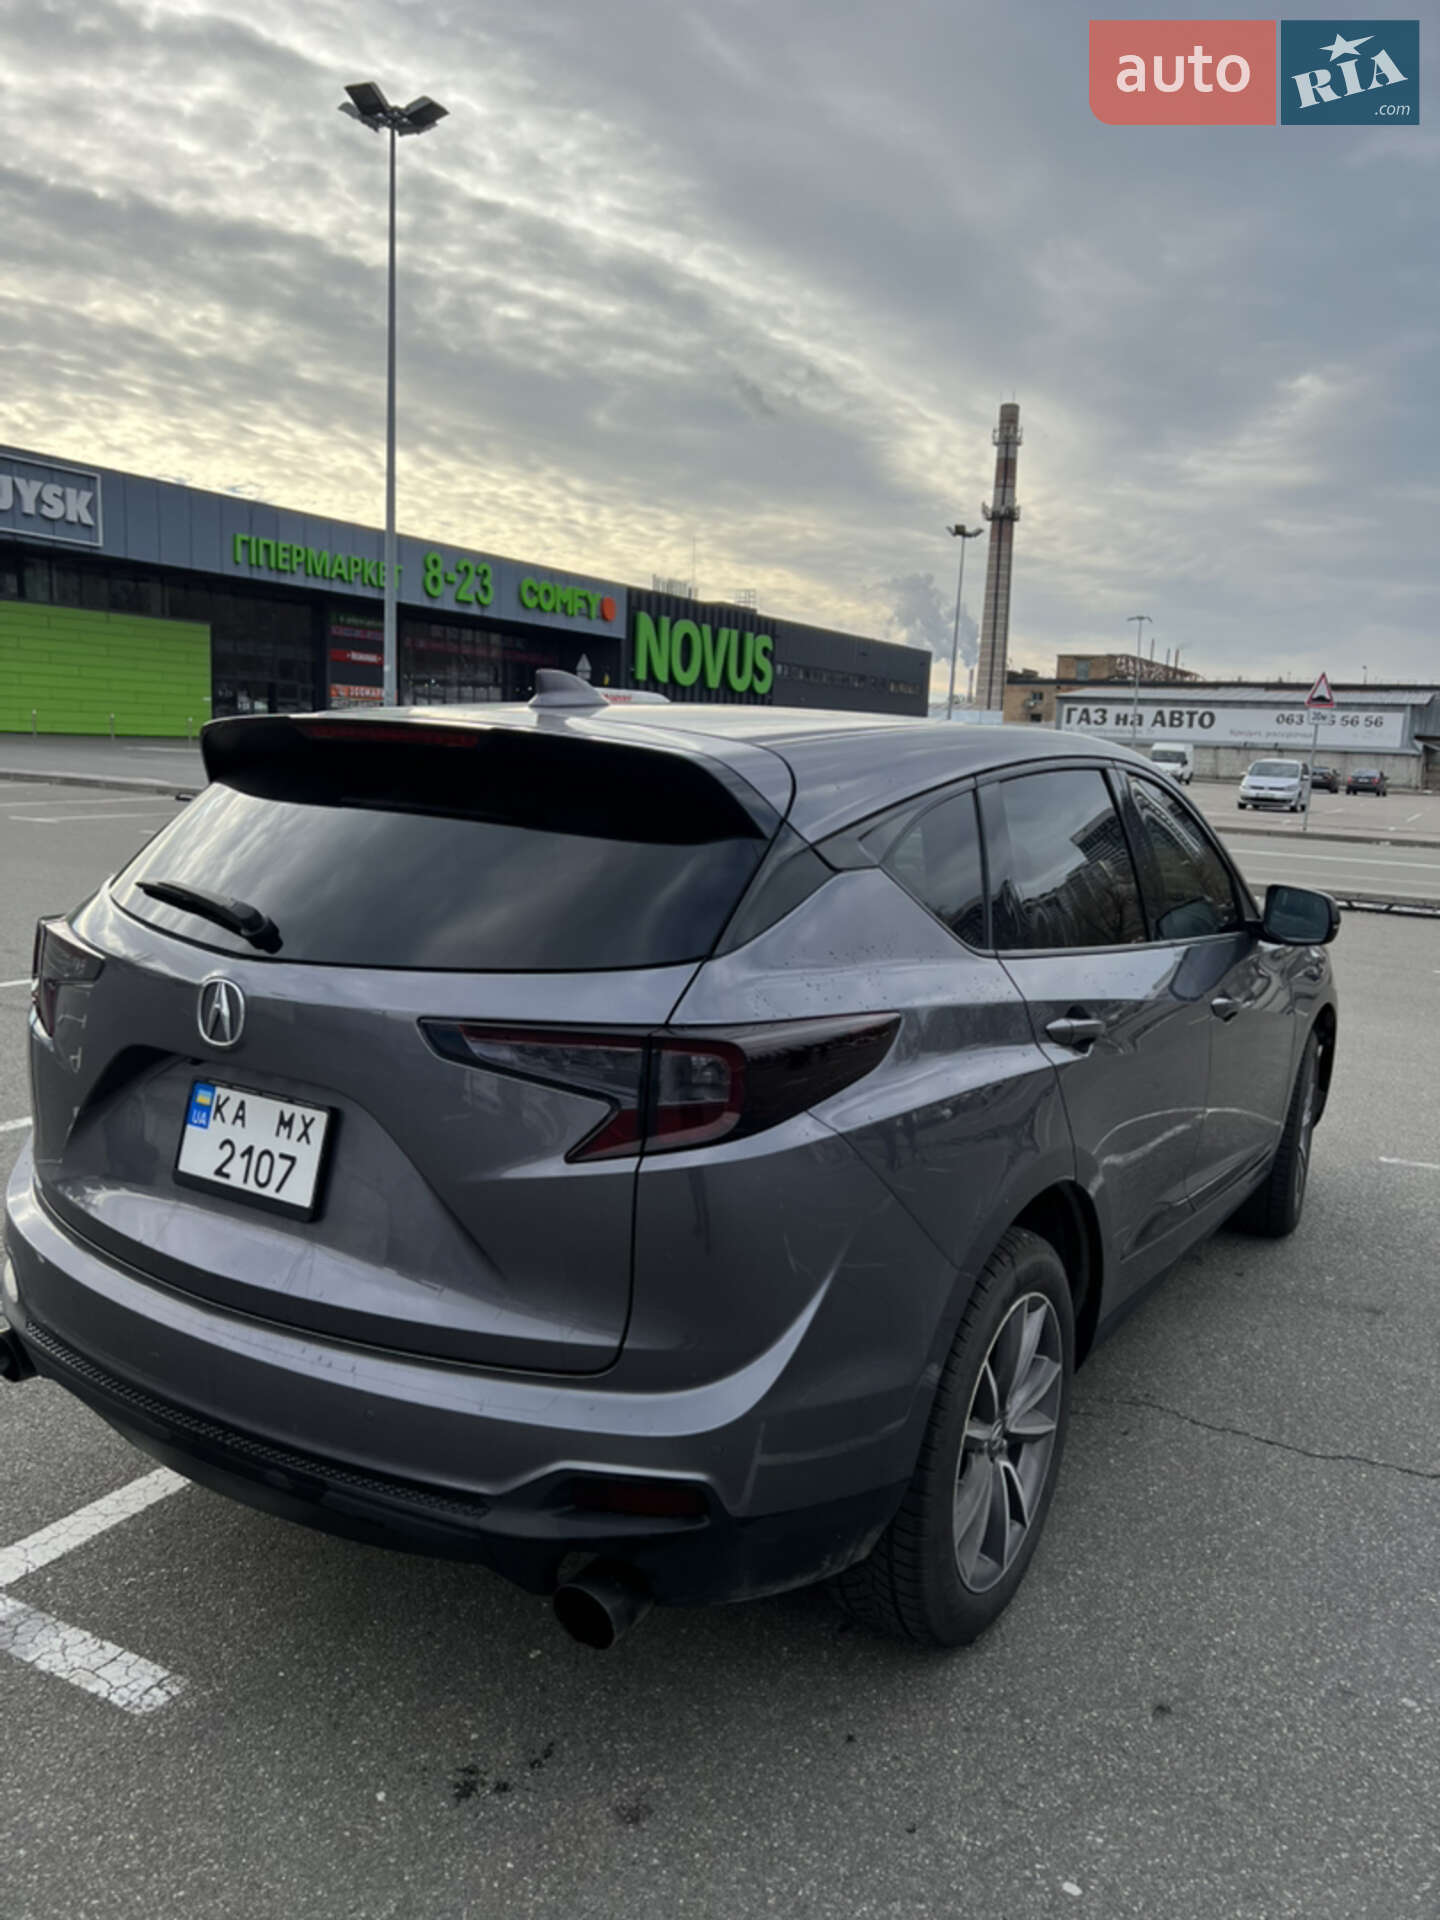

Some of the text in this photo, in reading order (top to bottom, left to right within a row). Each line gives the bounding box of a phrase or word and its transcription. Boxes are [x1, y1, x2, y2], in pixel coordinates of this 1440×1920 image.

[0, 474, 95, 526] JYSK
[423, 551, 494, 606] 8-23
[519, 577, 599, 620] COMFY
[635, 611, 774, 695] NOVUS
[1066, 707, 1216, 730] ГАЗ на АВТО
[1276, 713, 1305, 726] 063
[1340, 715, 1360, 728] 56
[1364, 716, 1384, 729] 56
[191, 1109, 208, 1126] UA
[213, 1093, 316, 1146] KA MX
[213, 1138, 297, 1194] 2107
